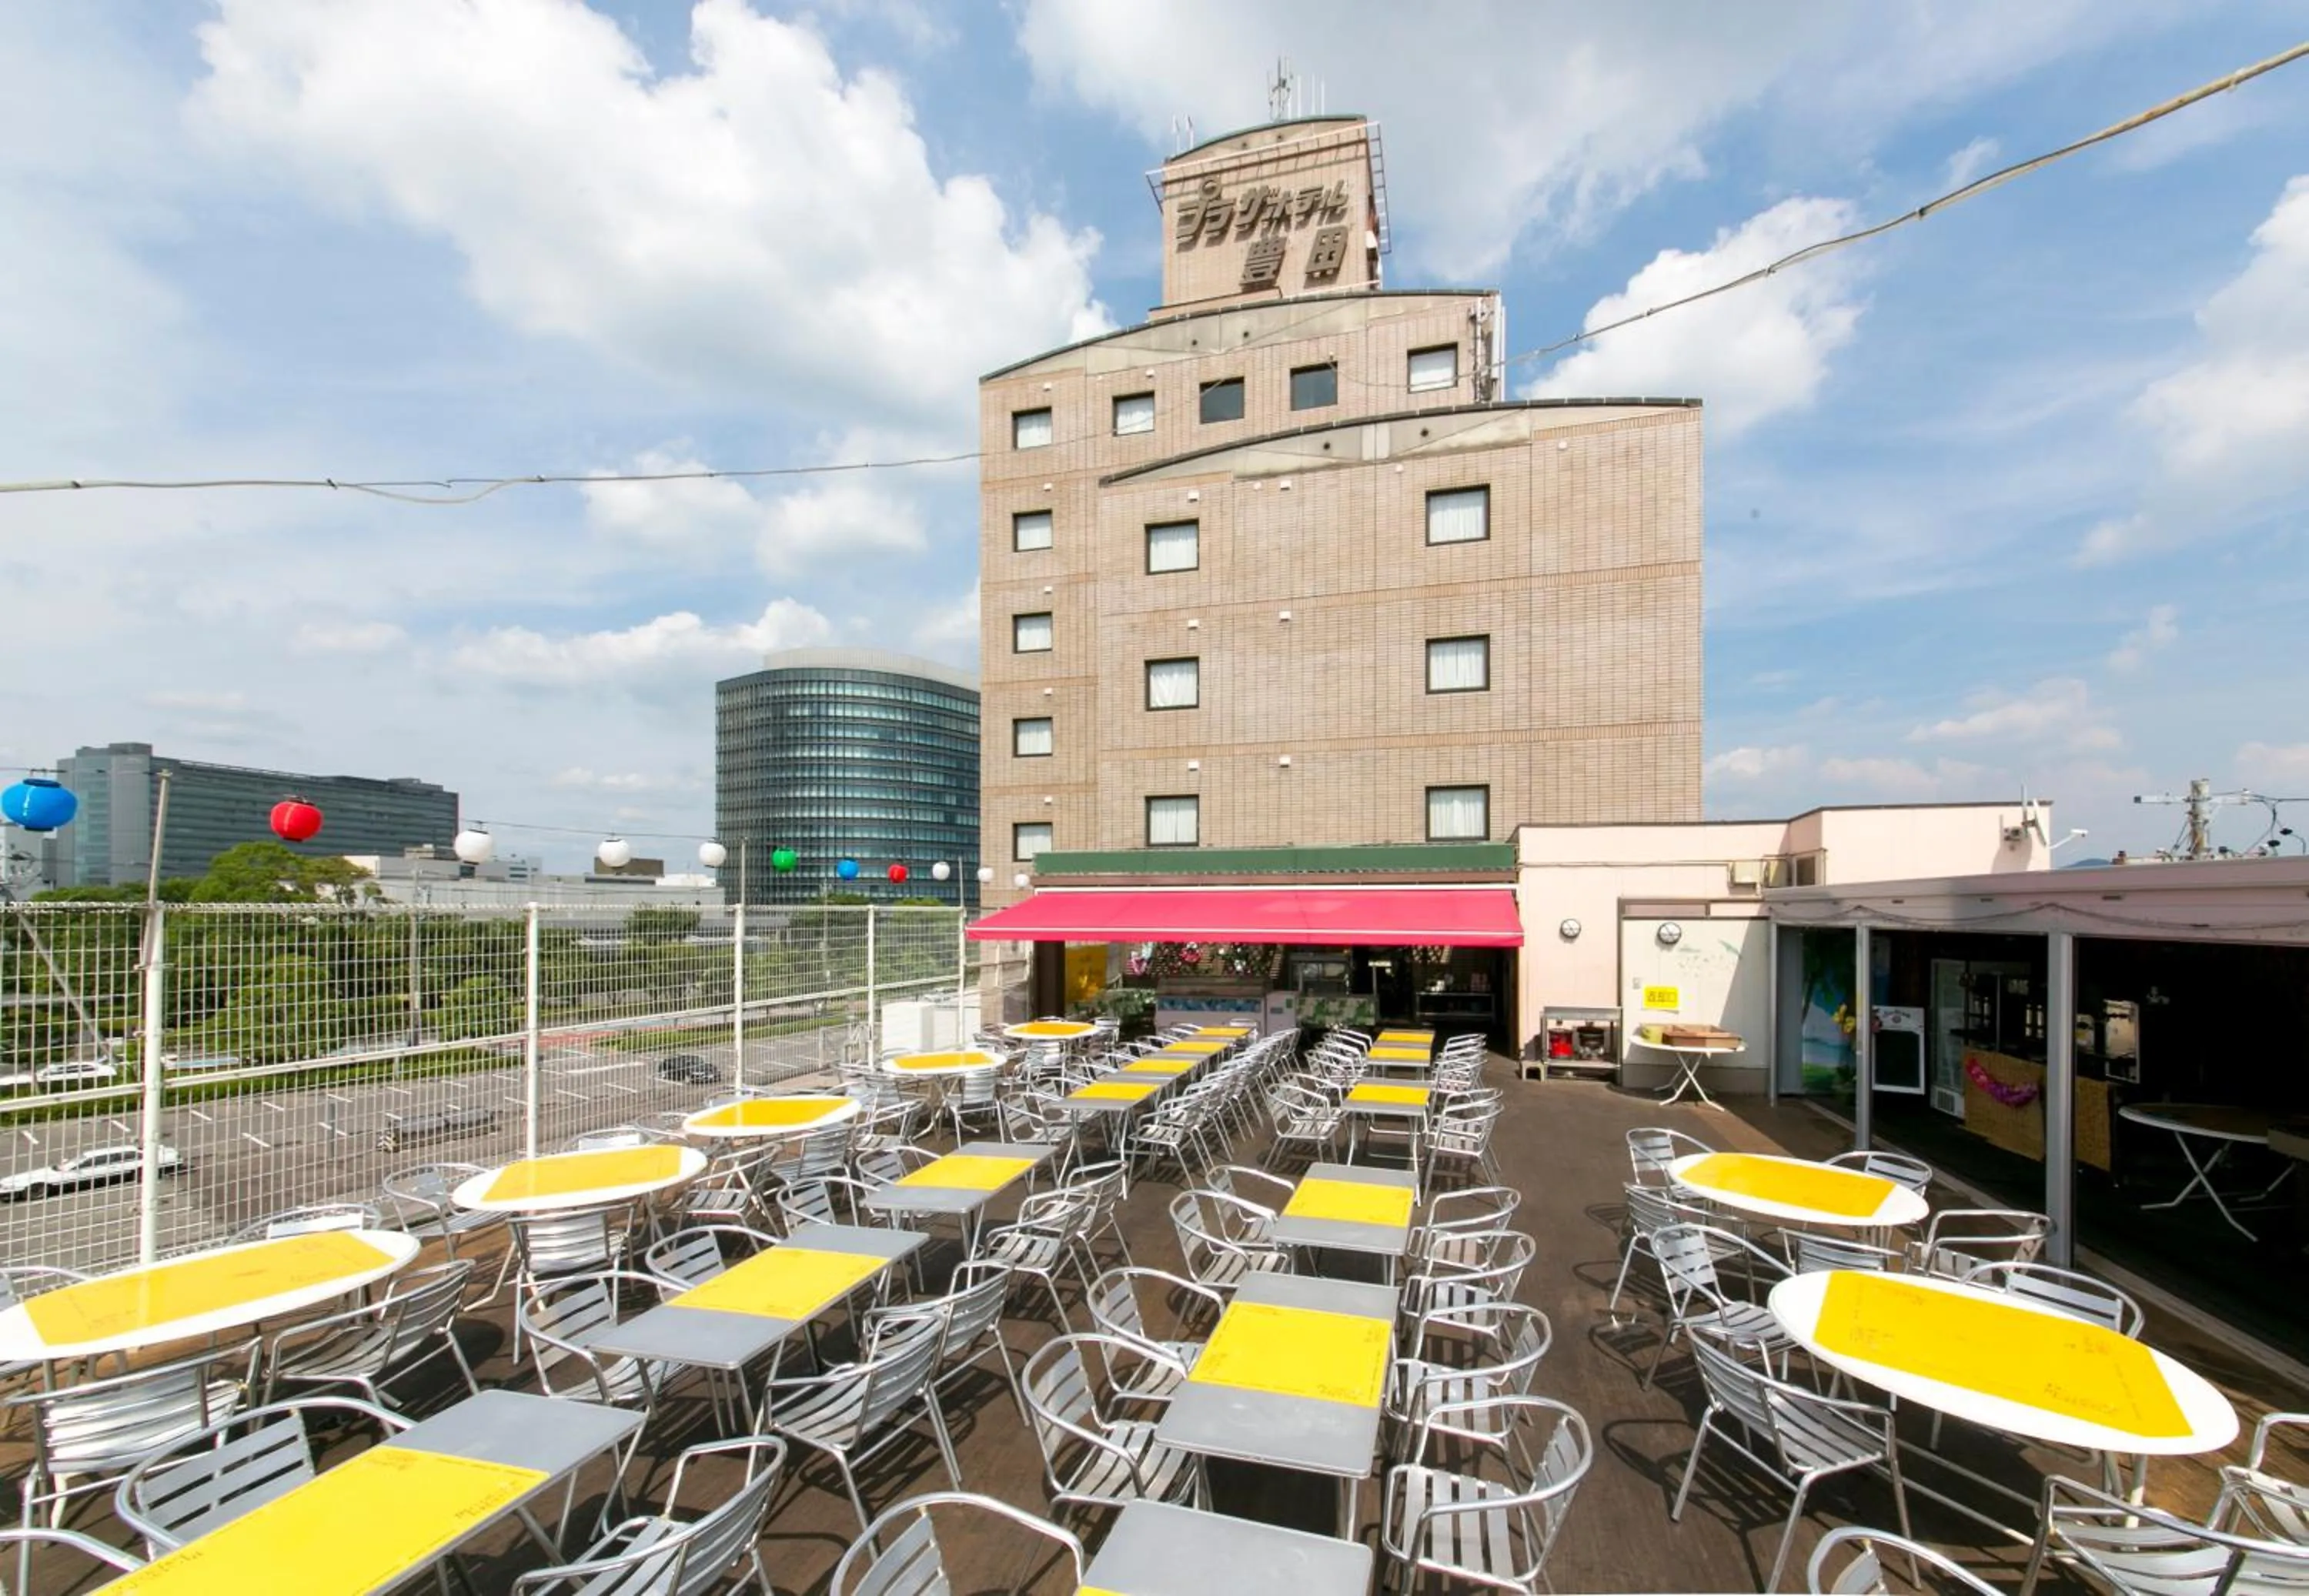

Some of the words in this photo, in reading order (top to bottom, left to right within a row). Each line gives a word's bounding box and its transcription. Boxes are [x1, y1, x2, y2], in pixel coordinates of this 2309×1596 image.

[1175, 179, 1349, 246] プラザホテル
[1239, 226, 1349, 285] 豊田
